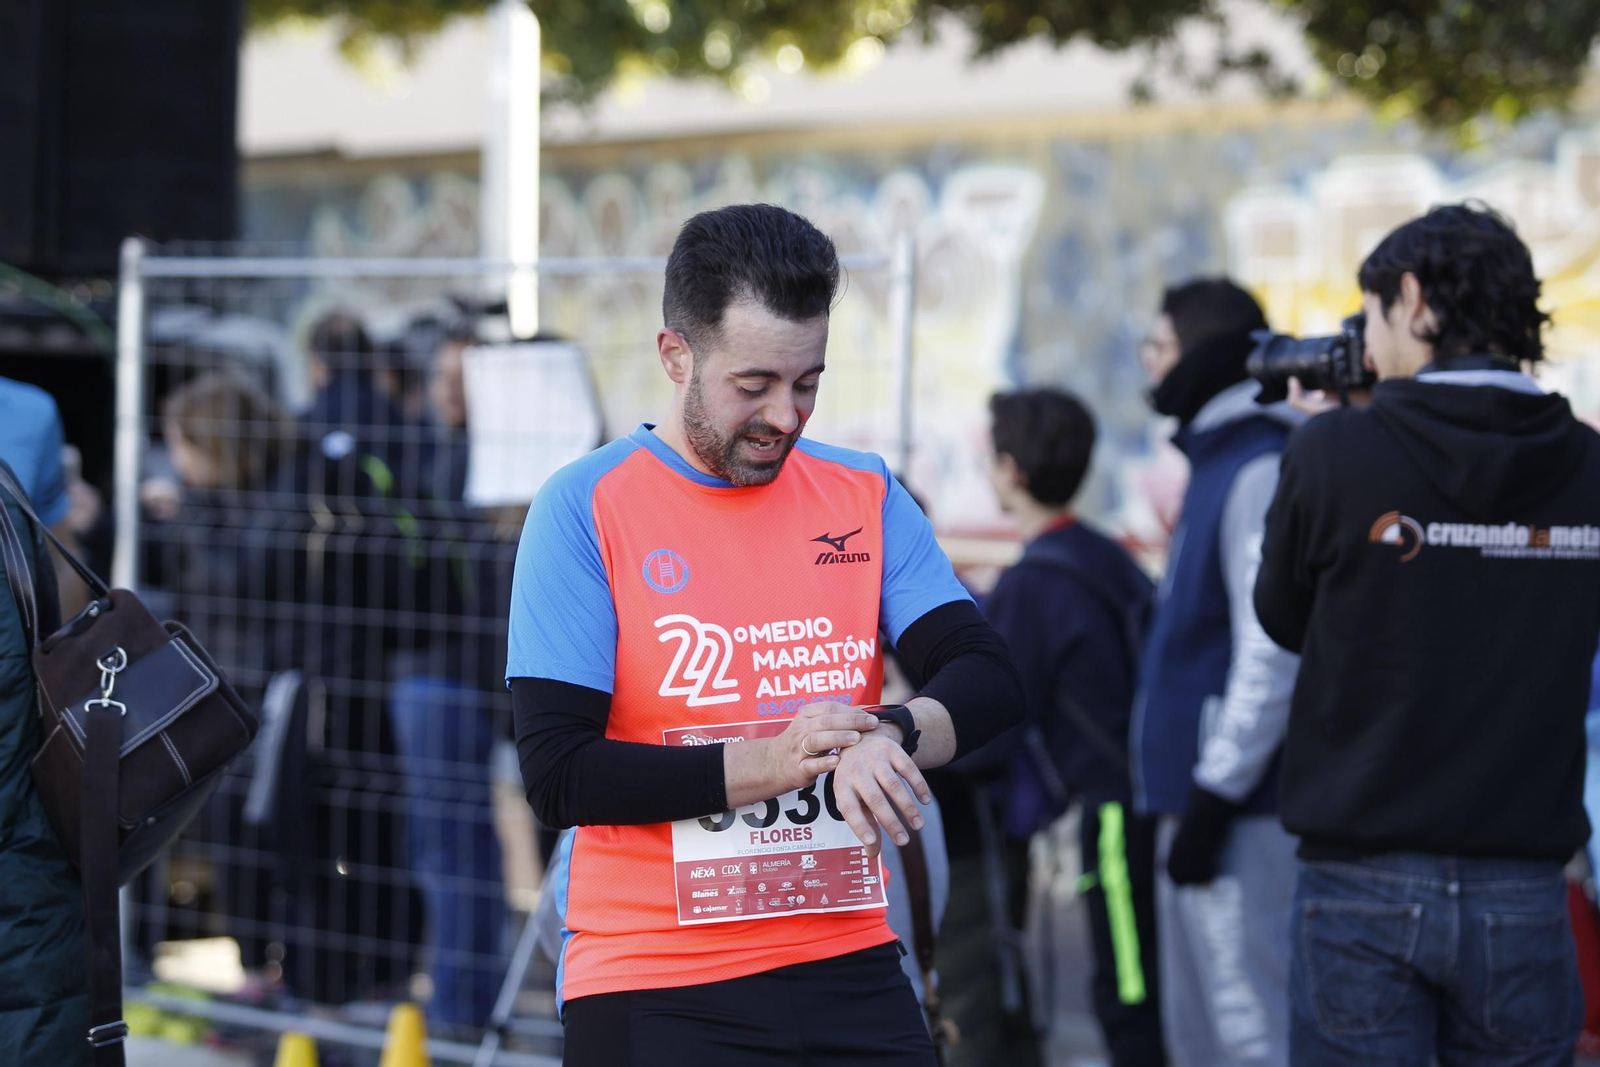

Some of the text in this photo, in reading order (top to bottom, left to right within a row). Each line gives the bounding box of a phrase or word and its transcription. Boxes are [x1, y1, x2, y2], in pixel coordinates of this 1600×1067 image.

[814, 551, 871, 566] MIZUNO
[749, 616, 833, 645] MEDIO
[752, 635, 876, 672] MARATÓN
[755, 662, 867, 699] ALMERÍA
[749, 827, 813, 845] FLORES
[737, 847, 772, 855] FLORENCIO
[792, 842, 826, 850] CABALLERO
[762, 858, 792, 868] ALMERÍA
[692, 890, 719, 899] Blanes
[702, 904, 729, 913] cajamar
